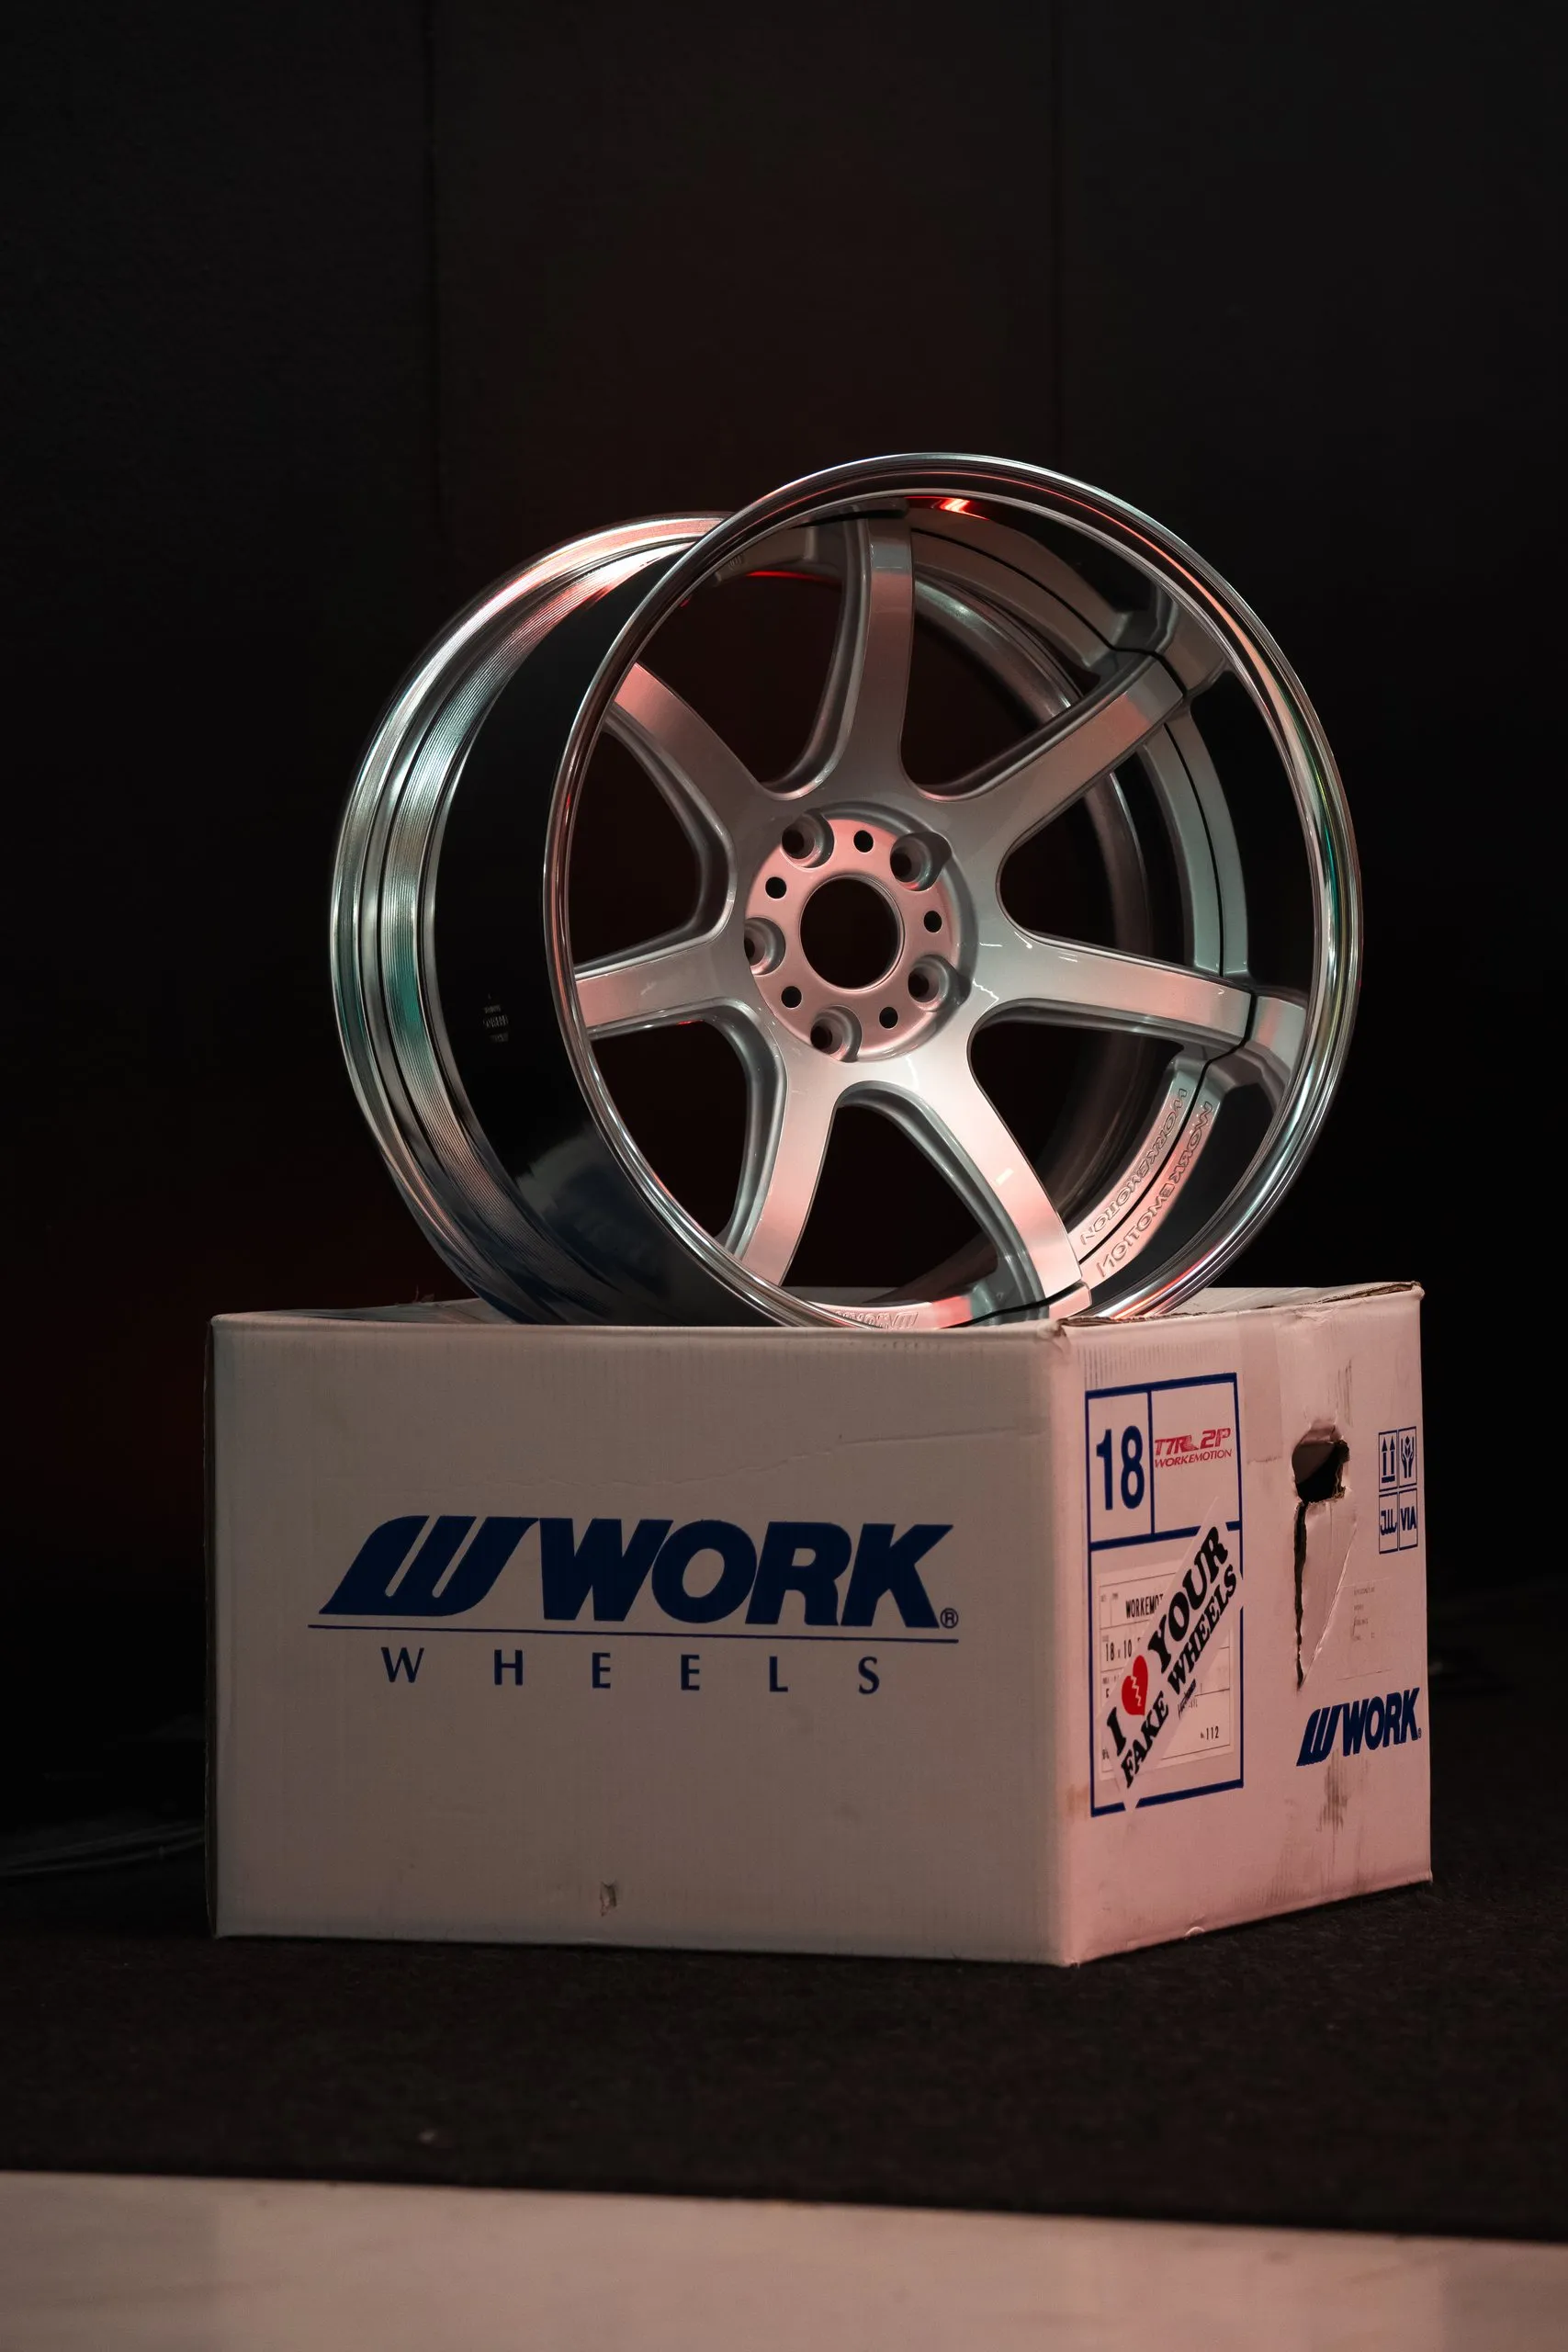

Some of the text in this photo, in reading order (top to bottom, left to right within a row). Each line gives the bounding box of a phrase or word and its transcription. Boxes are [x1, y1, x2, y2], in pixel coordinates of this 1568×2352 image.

[1096, 1425, 1145, 1510] 18
[1154, 1448, 1233, 1469] WORKEMOTION
[1400, 1505, 1417, 1532] VIA
[380, 1646, 880, 1695] WHEELS
[1105, 1642, 1115, 1662] 18
[1106, 1525, 1228, 1757] I YOUR
[1121, 1564, 1236, 1789] FAKE WHEELS
[1342, 1687, 1421, 1758] WORK
